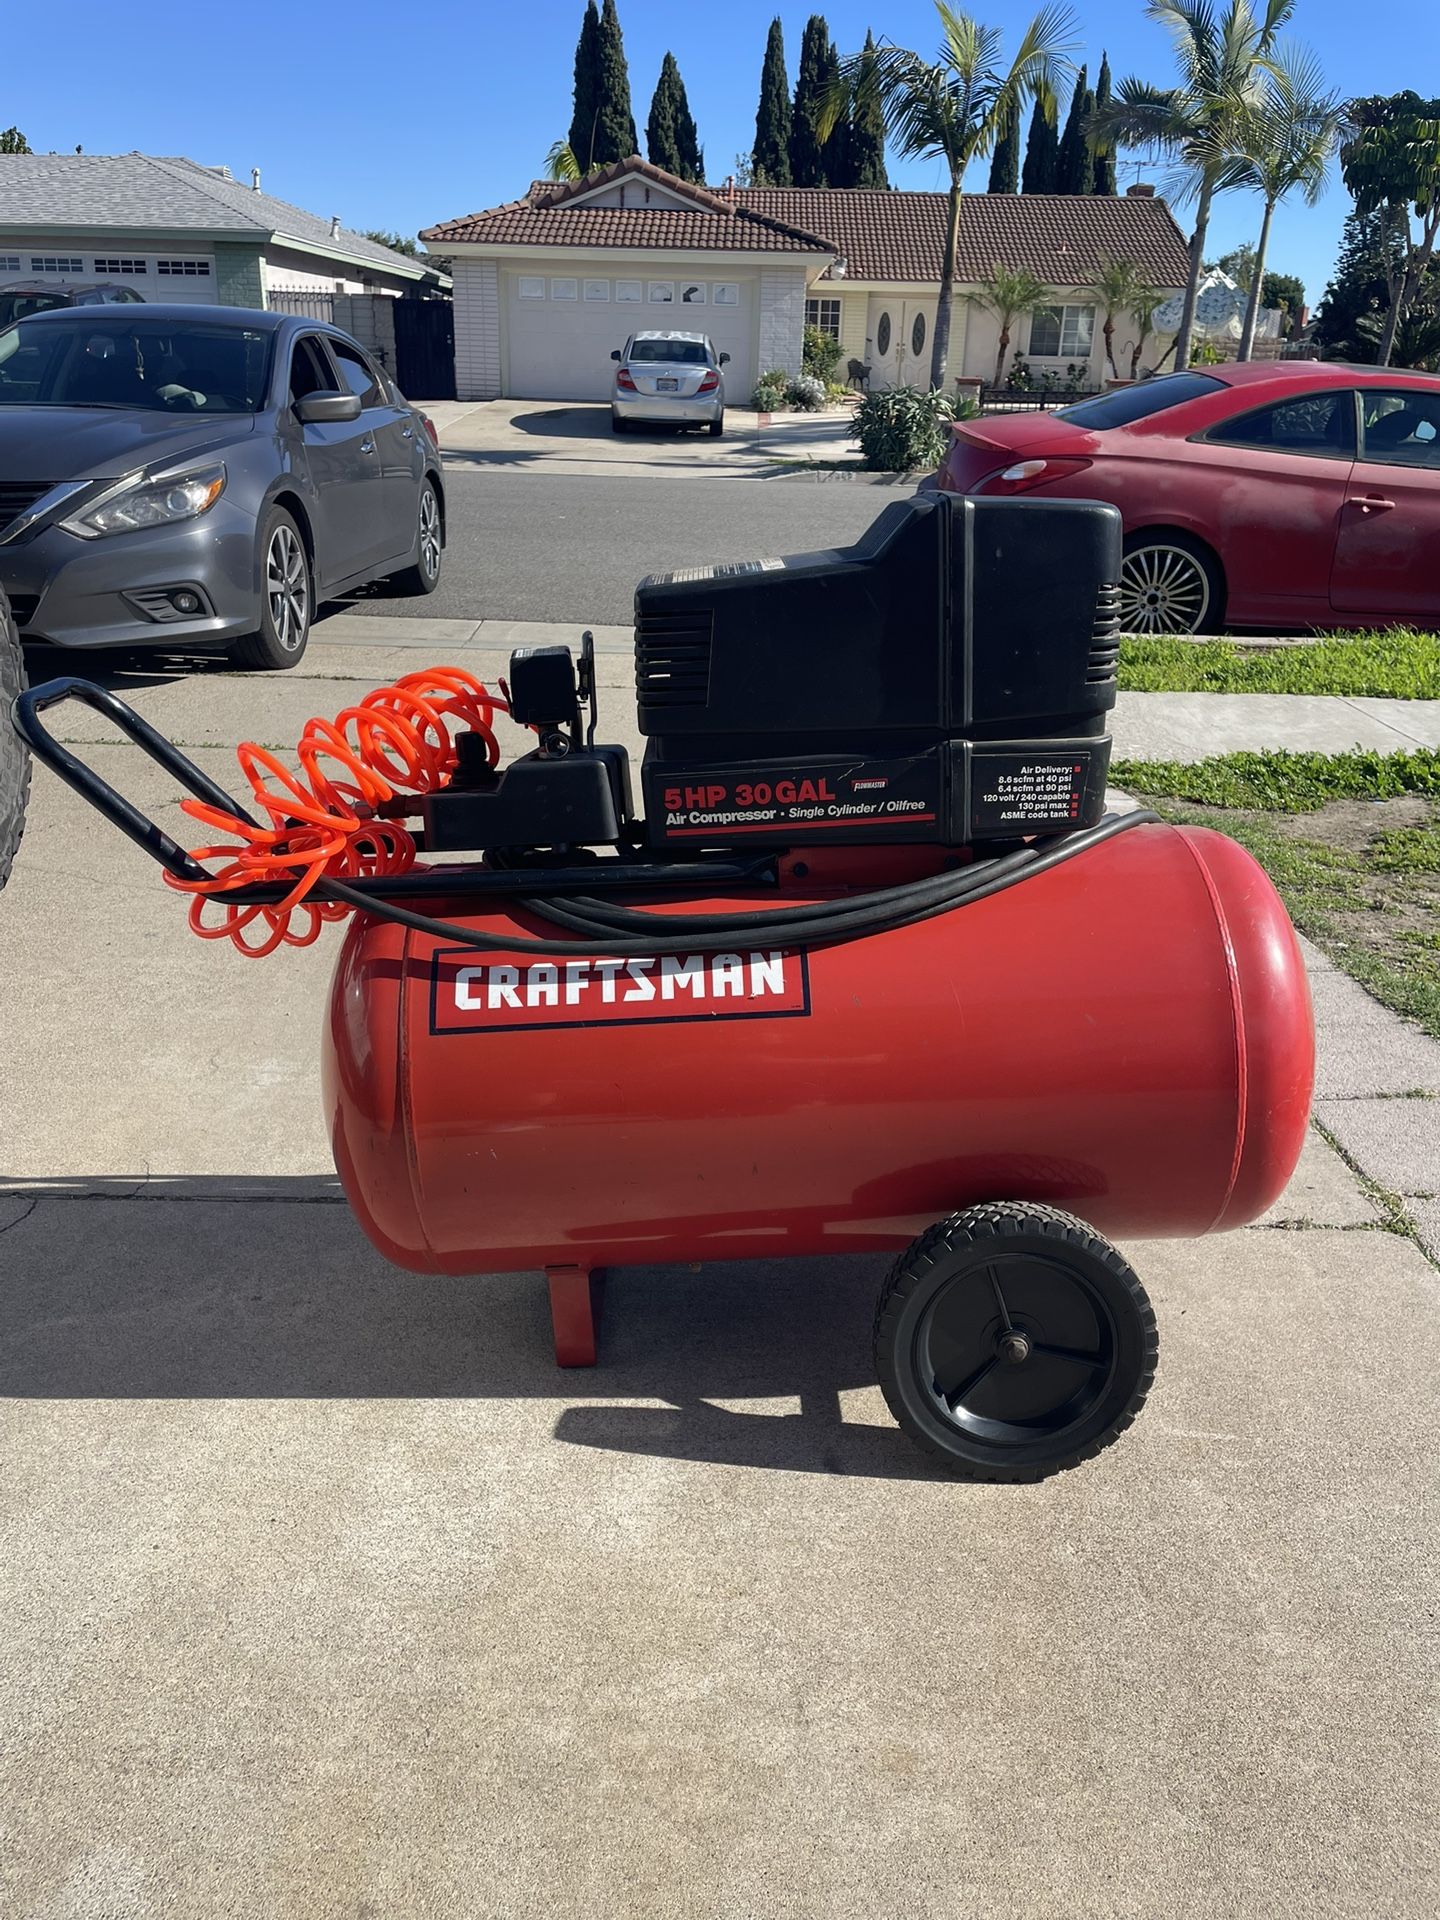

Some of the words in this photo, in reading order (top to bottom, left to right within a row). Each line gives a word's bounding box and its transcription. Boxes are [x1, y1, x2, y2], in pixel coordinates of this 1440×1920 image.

[1020, 766, 1034, 774] Air
[1035, 765, 1073, 775] Delivery:
[998, 775, 1012, 784] 8.6
[1013, 775, 1035, 783] scfm
[1036, 775, 1045, 783] at
[1046, 774, 1058, 783] 40
[1058, 774, 1072, 783] psi
[684, 785, 727, 809] HP
[735, 783, 772, 806] 30
[775, 777, 836, 804] GAL
[997, 784, 1011, 793] 6.4
[1012, 784, 1034, 792] scfm
[1035, 784, 1044, 792] at
[1045, 783, 1057, 792] 90
[1058, 783, 1071, 792] psi
[983, 794, 998, 802] 120
[999, 793, 1015, 802] volt
[1020, 793, 1037, 801] 240
[1037, 792, 1071, 802] capable
[1018, 802, 1034, 810] 130
[1034, 801, 1048, 811] psi
[665, 812, 687, 825] Air
[688, 809, 777, 825] Compressor
[788, 806, 825, 819] Single
[827, 803, 877, 817] Cylinder
[886, 799, 926, 812] Oilfree
[1000, 811, 1027, 819] ASME
[1027, 811, 1049, 819] code
[1050, 810, 1069, 818] tank
[454, 950, 785, 1011] CRAFTSMAN
